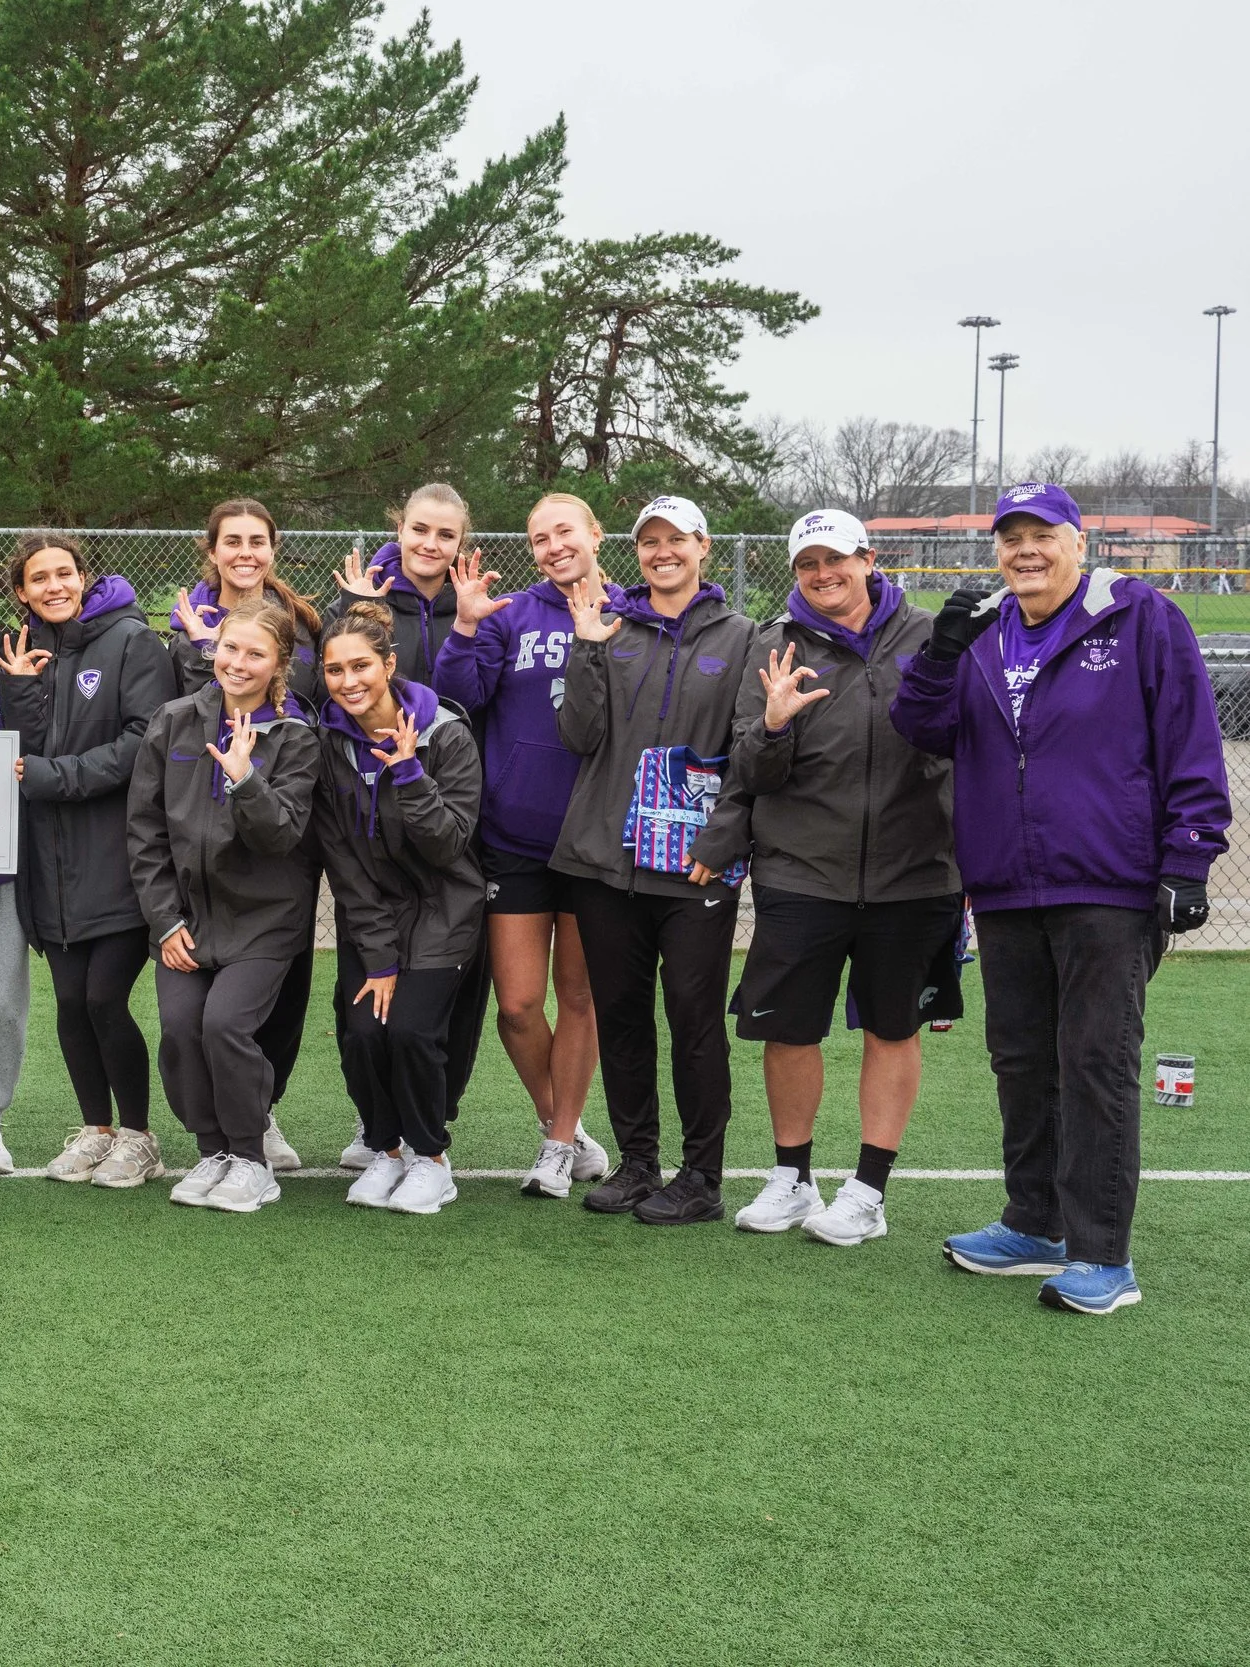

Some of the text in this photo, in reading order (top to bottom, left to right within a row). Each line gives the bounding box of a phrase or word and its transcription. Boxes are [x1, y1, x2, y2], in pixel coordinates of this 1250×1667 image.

[798, 525, 835, 540] K-STATE
[1082, 638, 1119, 647] K-STTE
[514, 630, 574, 672] K-S
[1080, 658, 1118, 672] WILDCATS
